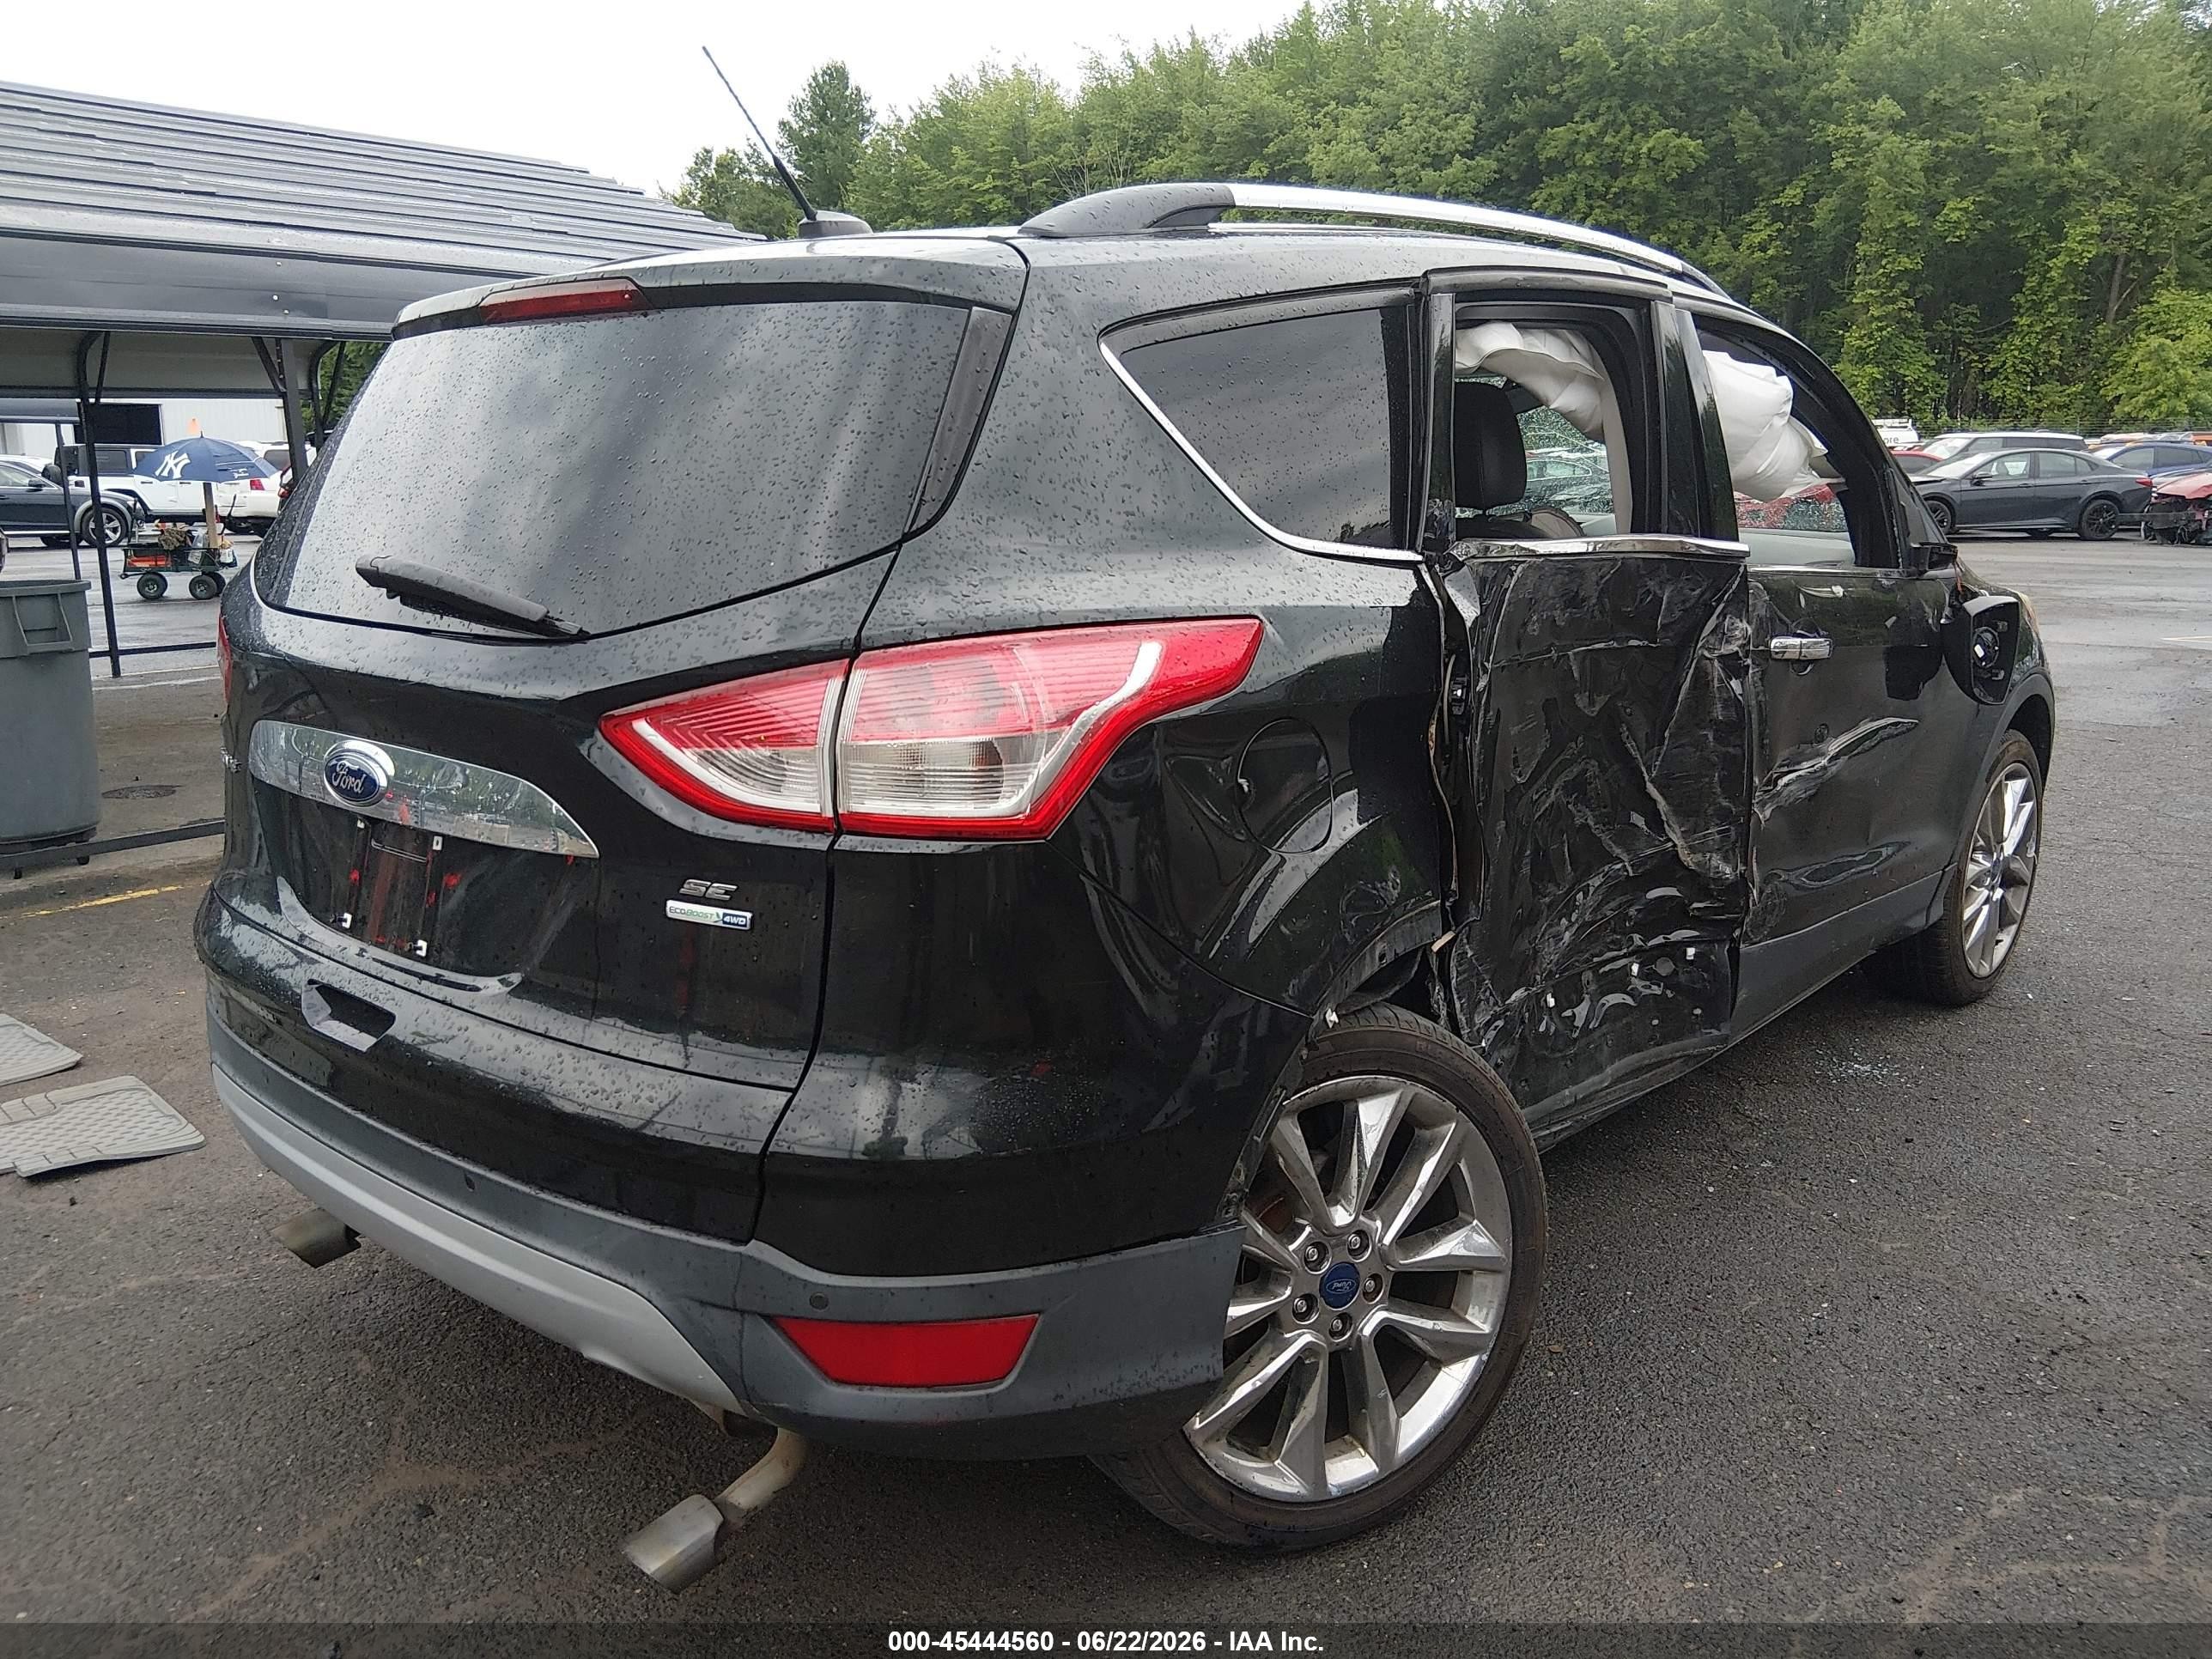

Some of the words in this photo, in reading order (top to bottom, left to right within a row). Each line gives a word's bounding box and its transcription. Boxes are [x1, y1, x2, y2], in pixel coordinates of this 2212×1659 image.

[155, 450, 191, 479] NY
[330, 760, 368, 794] Ford
[679, 879, 738, 901] SE
[724, 915, 746, 925] 4WD
